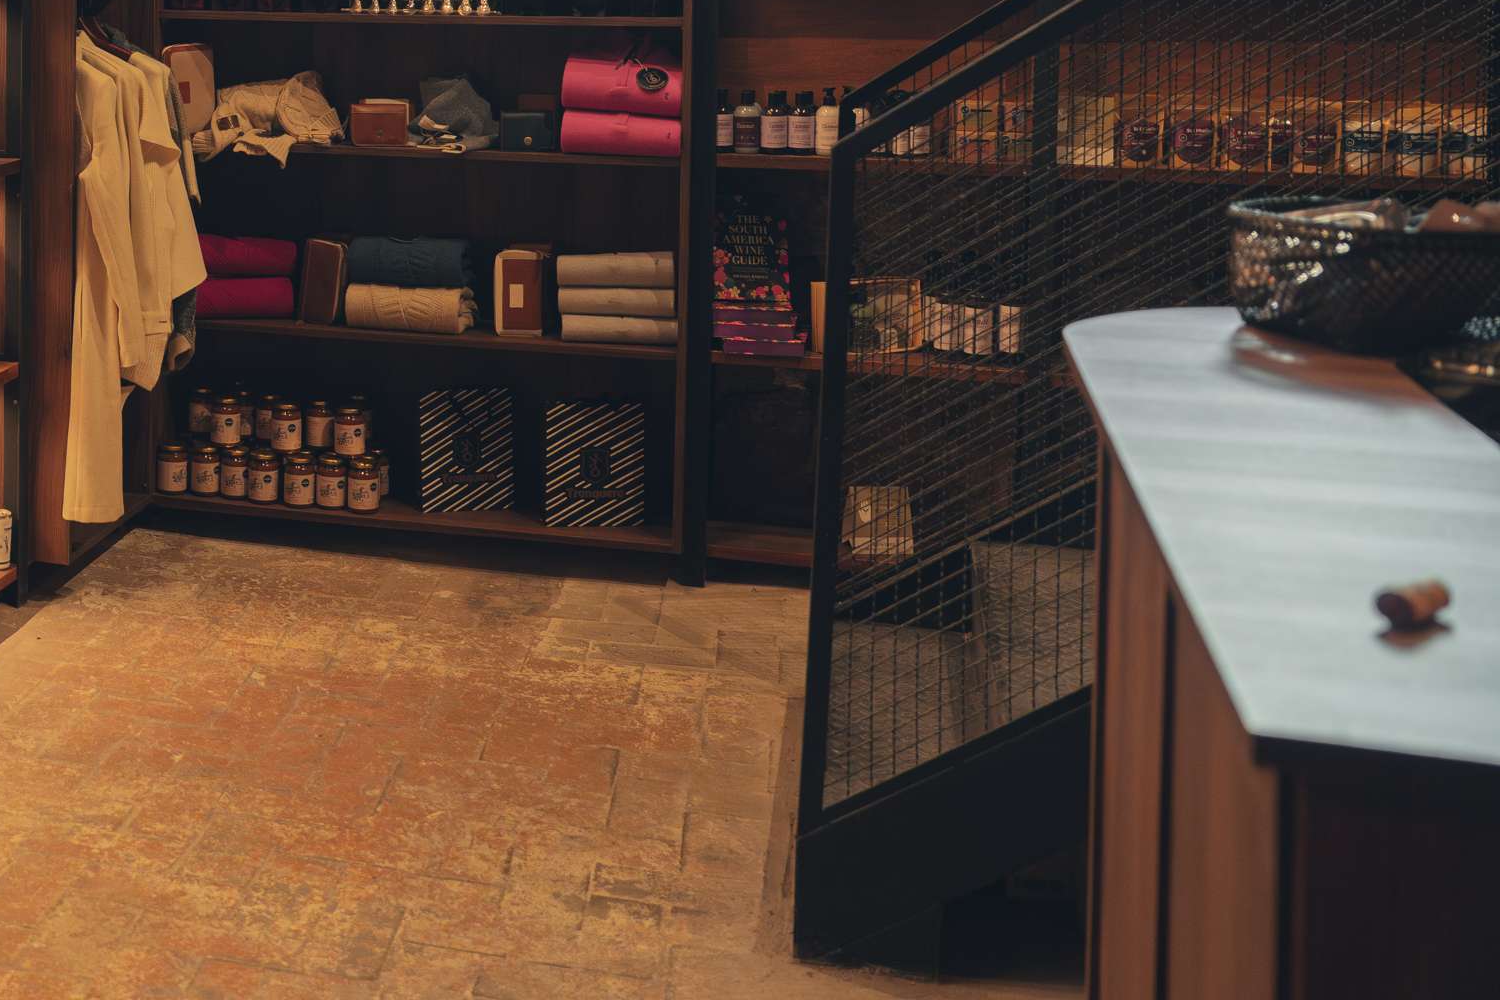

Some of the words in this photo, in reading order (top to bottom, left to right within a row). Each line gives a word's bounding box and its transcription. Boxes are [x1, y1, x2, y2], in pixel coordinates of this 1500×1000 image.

[736, 215, 760, 224] THE
[728, 224, 768, 235] SOUTH
[723, 234, 775, 245] AMERICA
[734, 245, 765, 255] WINE
[731, 255, 768, 266] GUIDE
